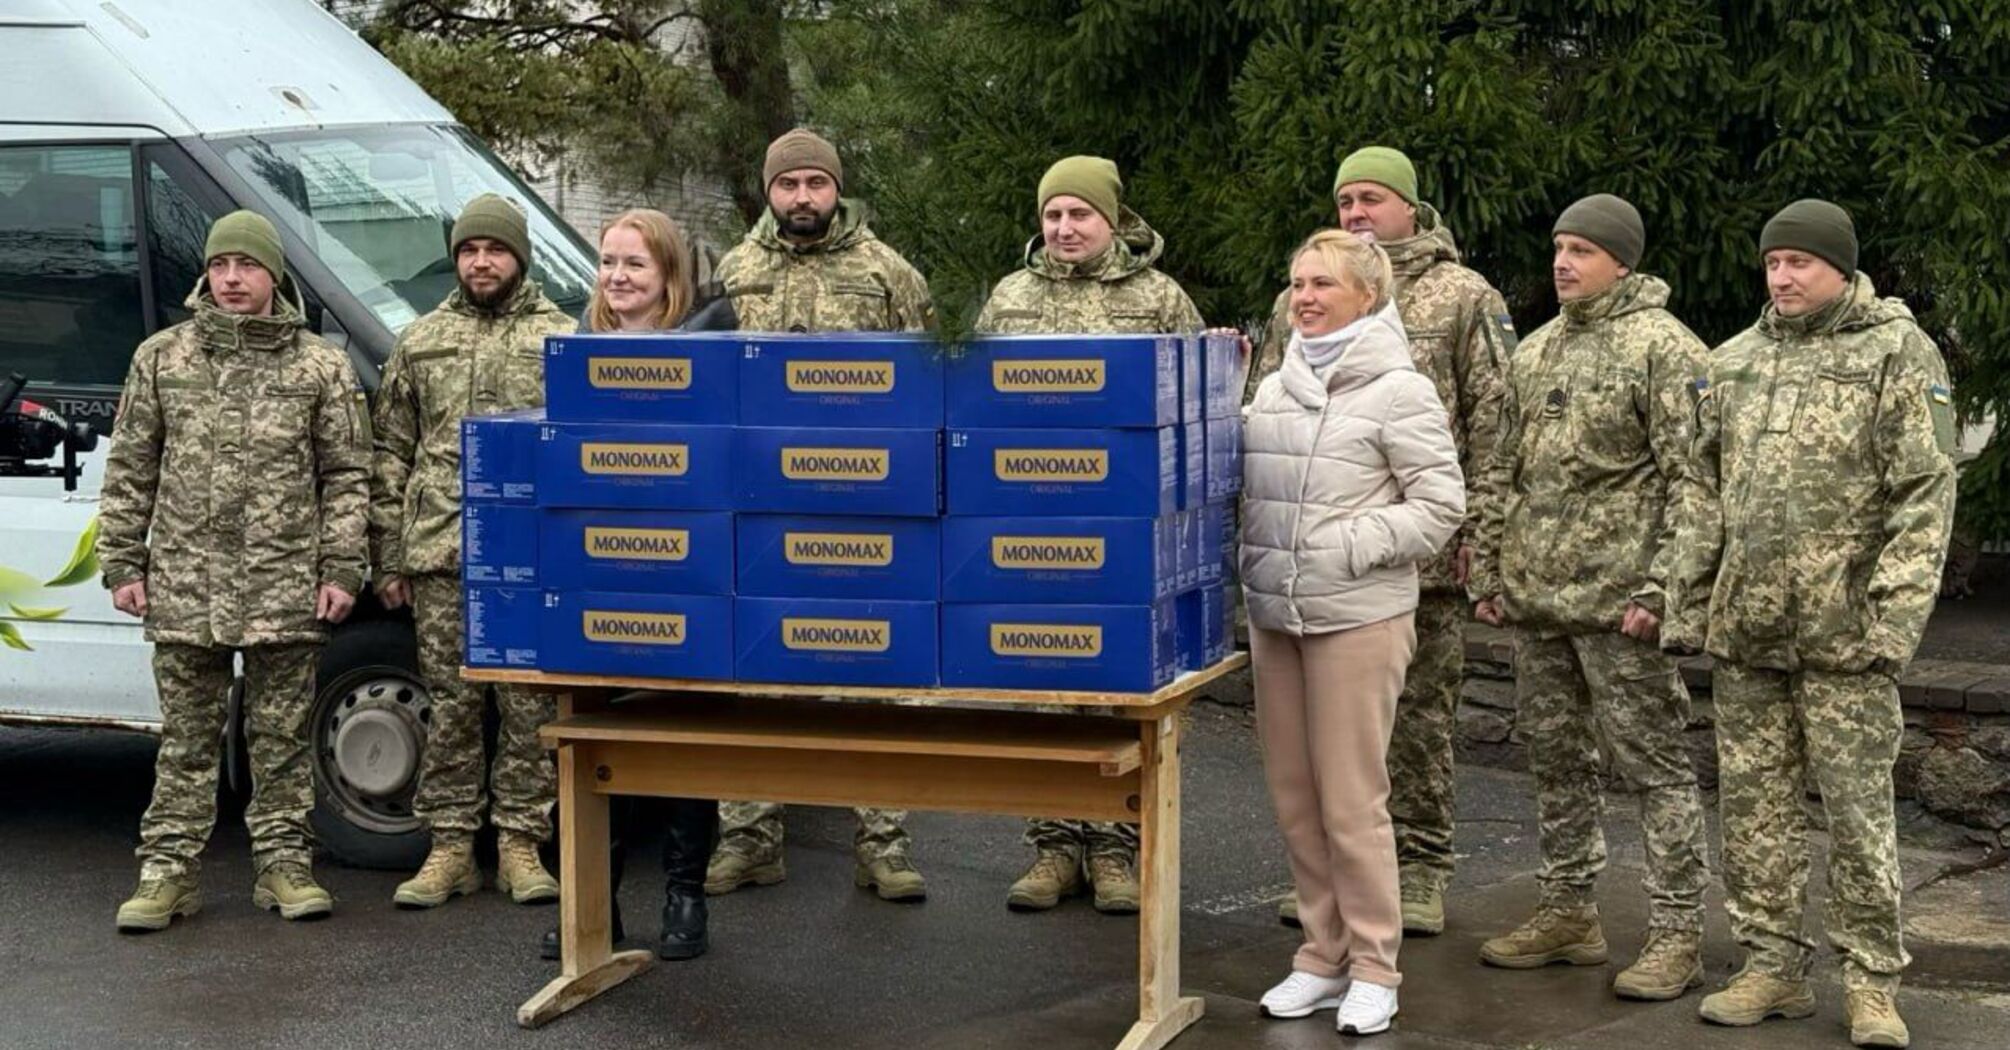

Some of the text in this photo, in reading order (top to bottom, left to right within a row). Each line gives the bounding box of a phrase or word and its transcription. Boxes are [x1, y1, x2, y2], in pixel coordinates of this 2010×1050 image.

[597, 366, 685, 383] MONOMAX
[795, 369, 887, 385] MONOMAX
[1002, 368, 1097, 385] MONOMAX
[590, 452, 681, 469] MONOMAX
[789, 456, 882, 473] MONOMAX
[1004, 457, 1101, 474] MONOMAX
[593, 535, 682, 553] MONOMAX
[793, 541, 886, 559] MONOMAX
[1001, 544, 1097, 562] MONOMAX
[592, 619, 679, 637] MONOMAX
[791, 627, 883, 645] MONOMAX
[999, 632, 1095, 650] MONOMAX
